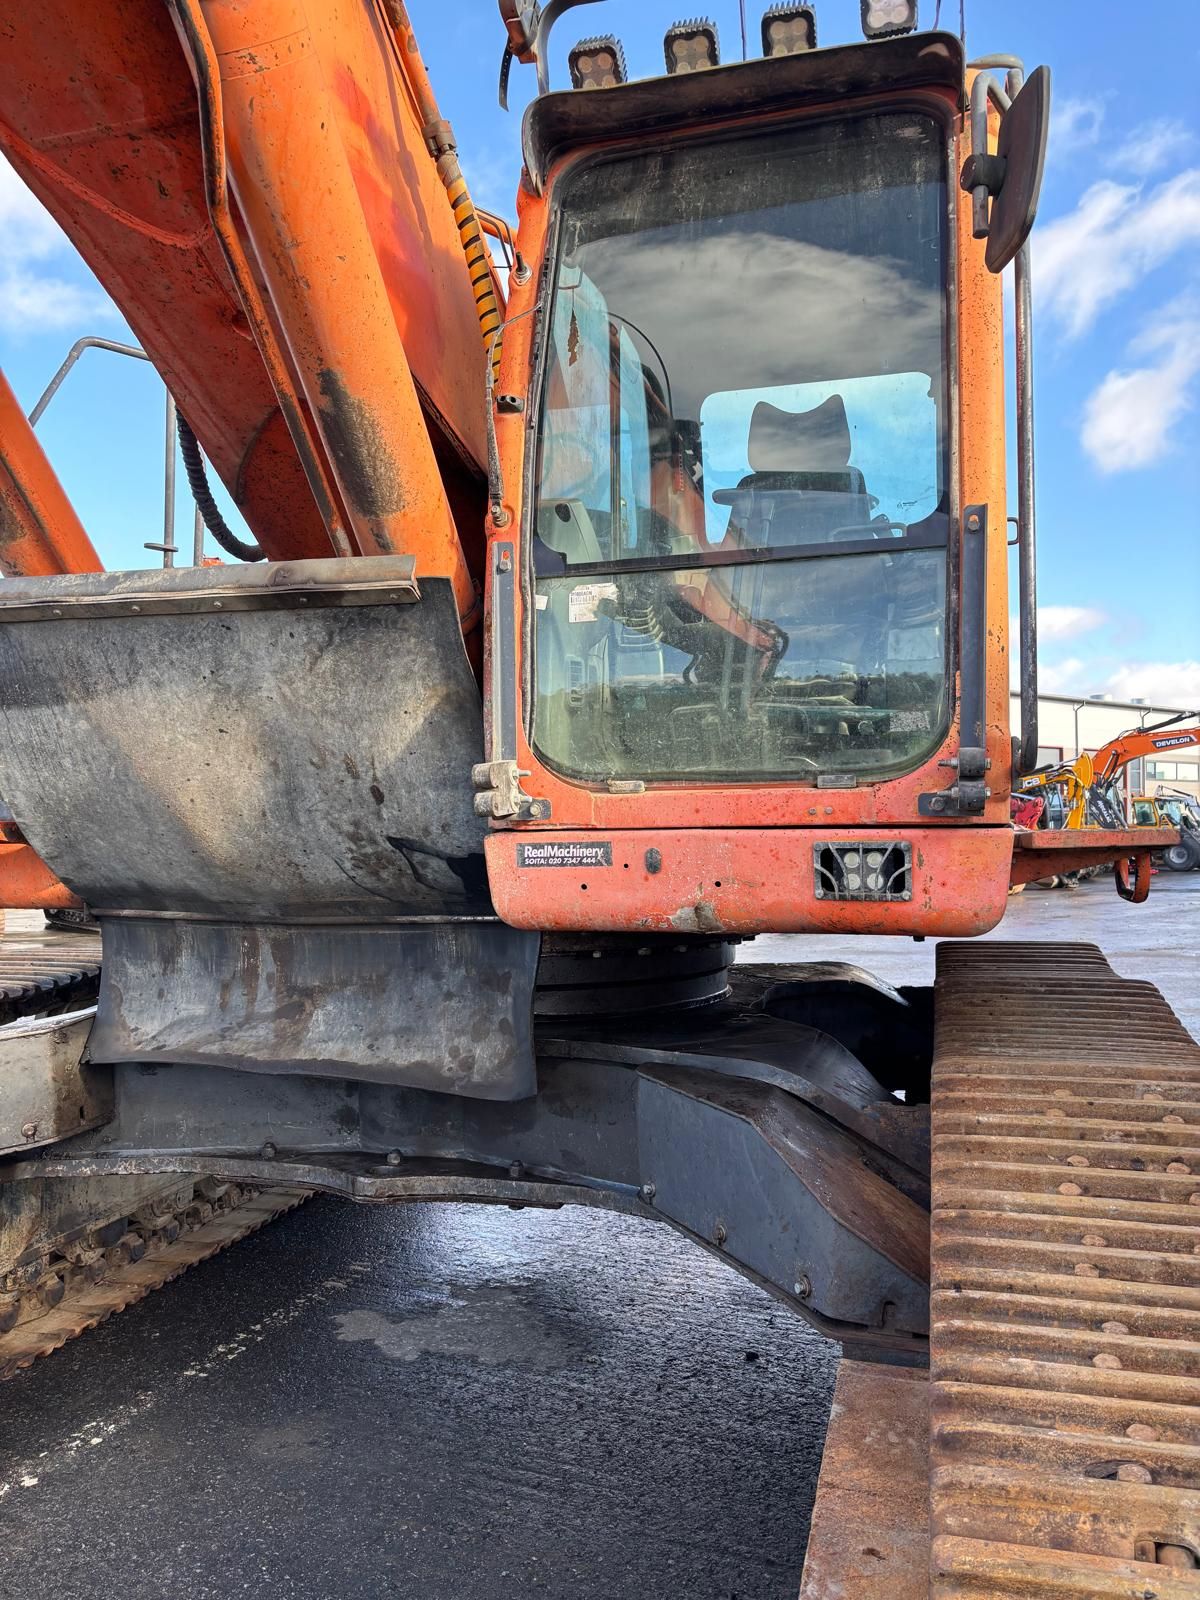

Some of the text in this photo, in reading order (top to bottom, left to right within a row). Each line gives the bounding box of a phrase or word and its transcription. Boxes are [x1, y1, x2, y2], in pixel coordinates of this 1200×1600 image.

[1156, 736, 1189, 747] DEVELON
[1022, 778, 1040, 788] JCB
[525, 845, 603, 859] RealMachinery
